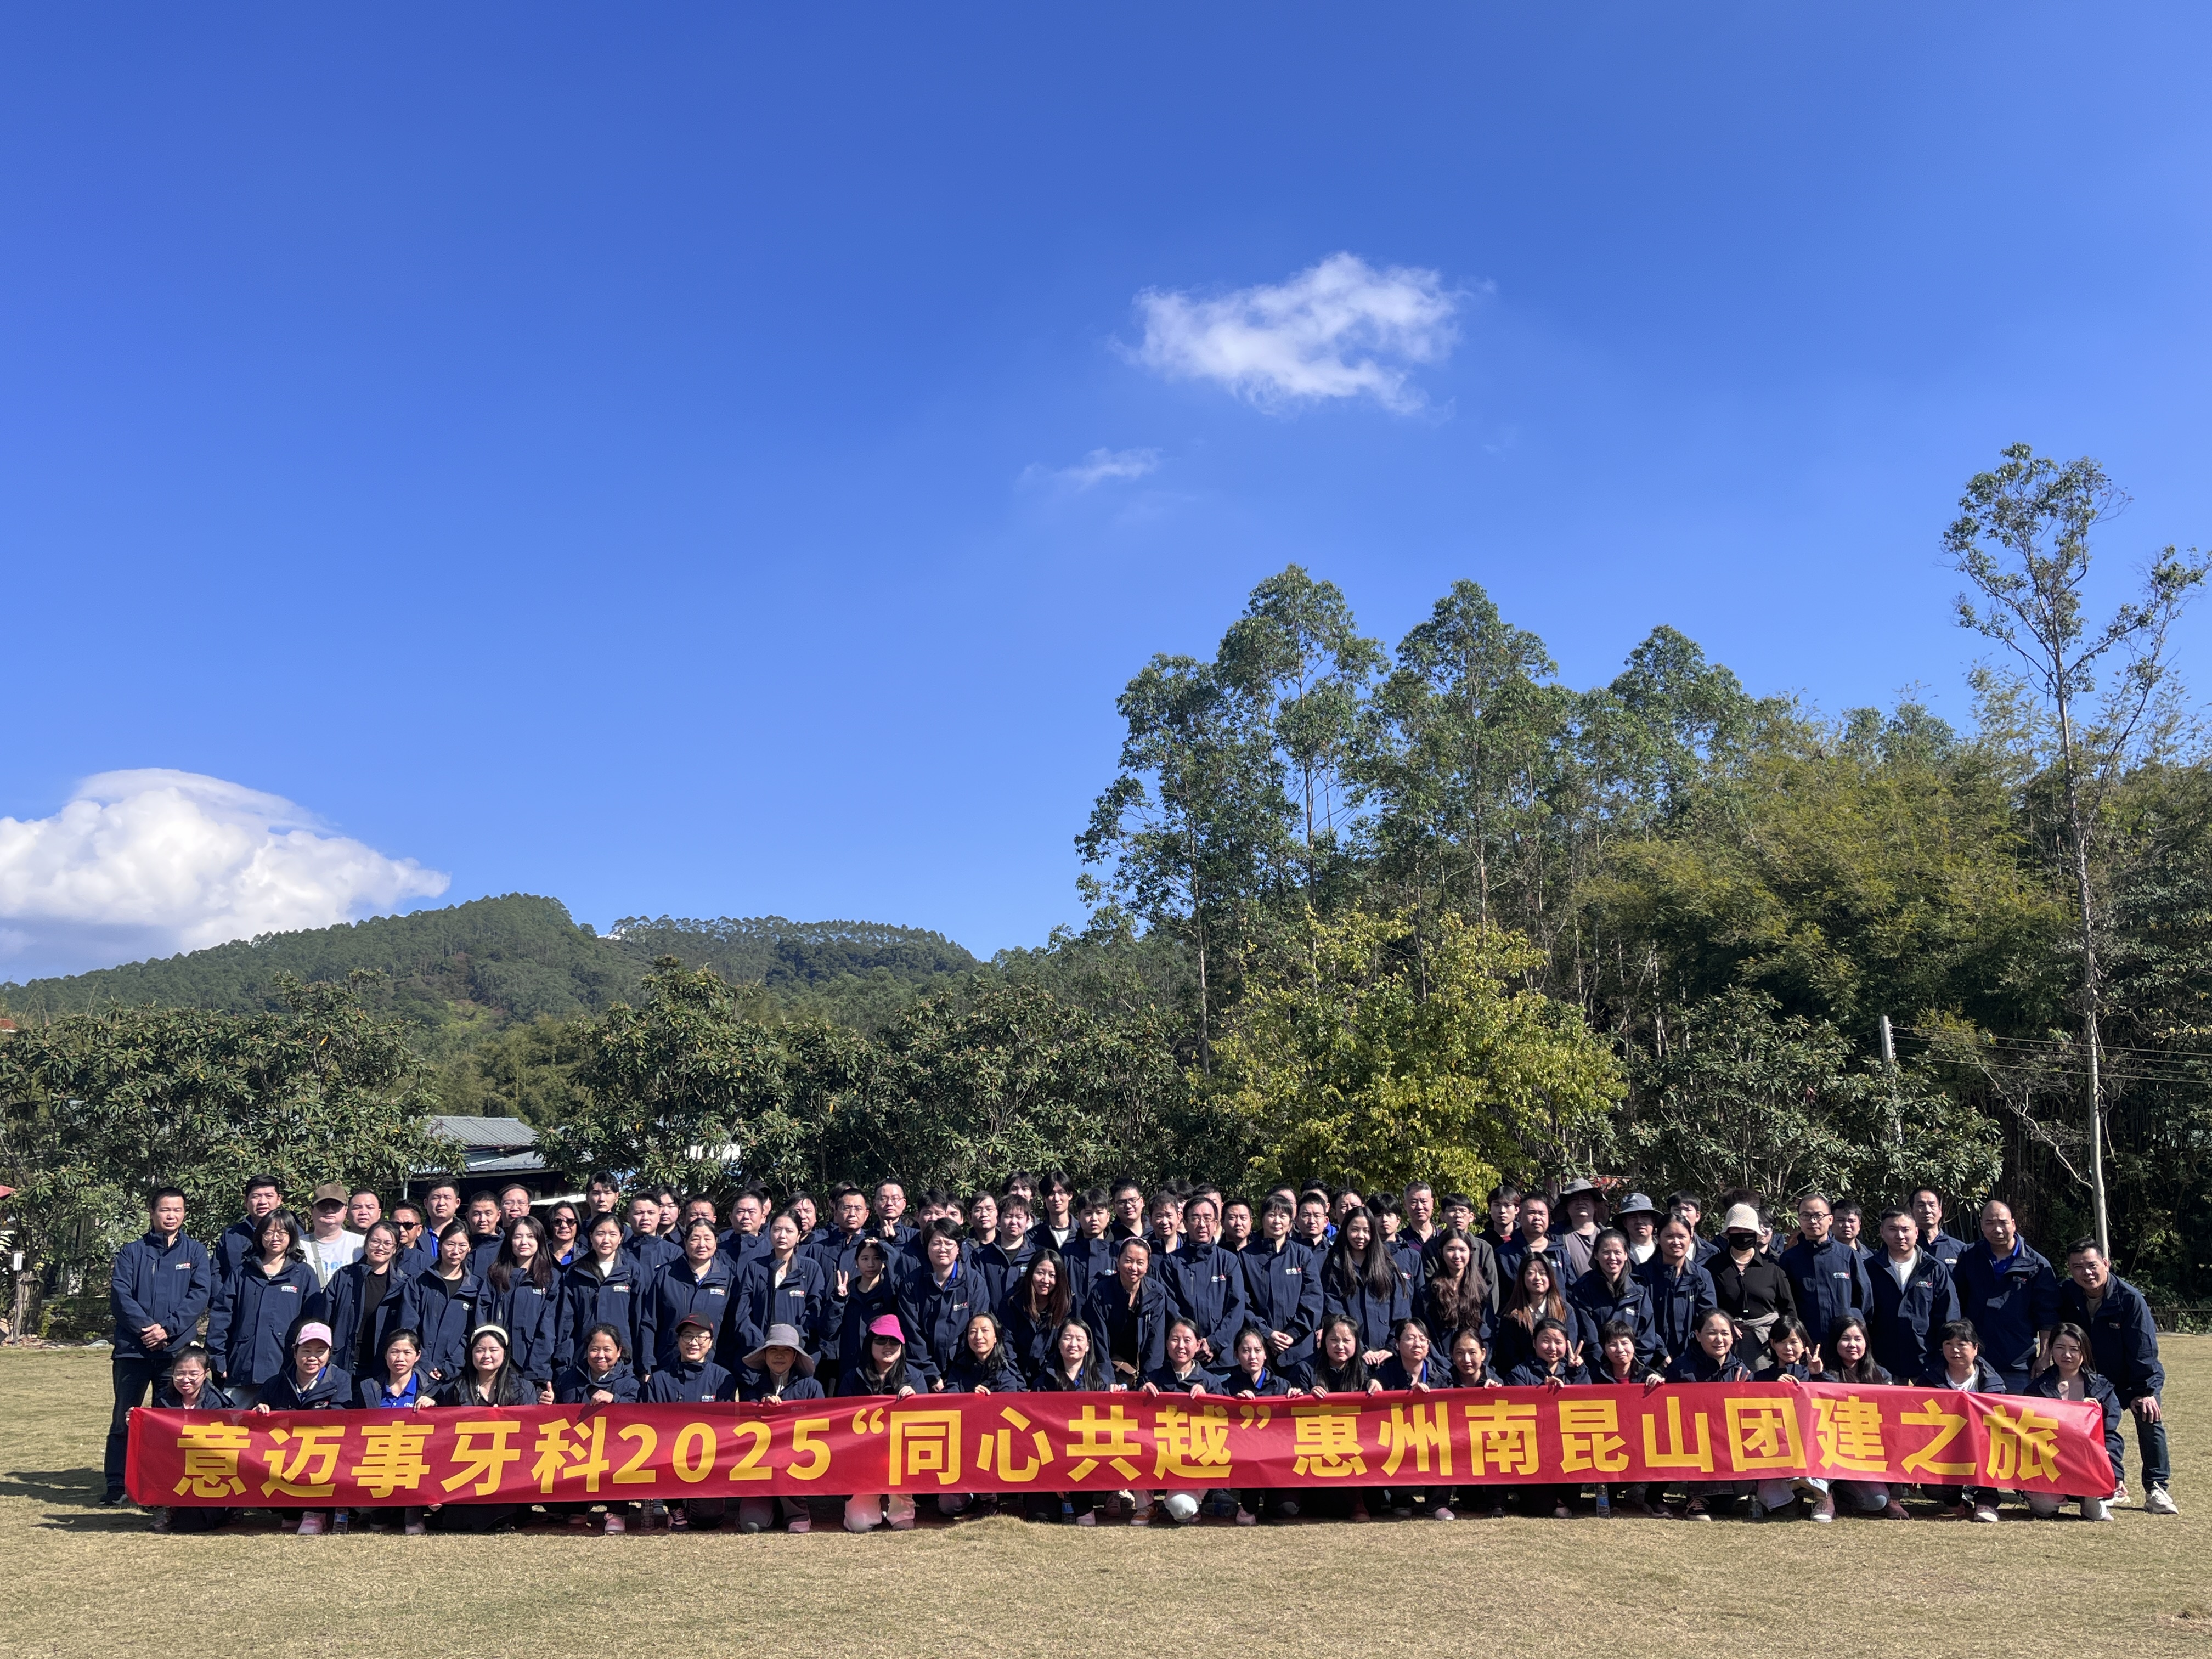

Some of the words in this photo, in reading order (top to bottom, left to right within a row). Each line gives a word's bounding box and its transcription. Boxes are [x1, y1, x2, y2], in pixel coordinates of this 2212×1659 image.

[174, 1396, 2059, 1498] 意迈事牙科2025“同心共越”惠州南昆山团建之旅
